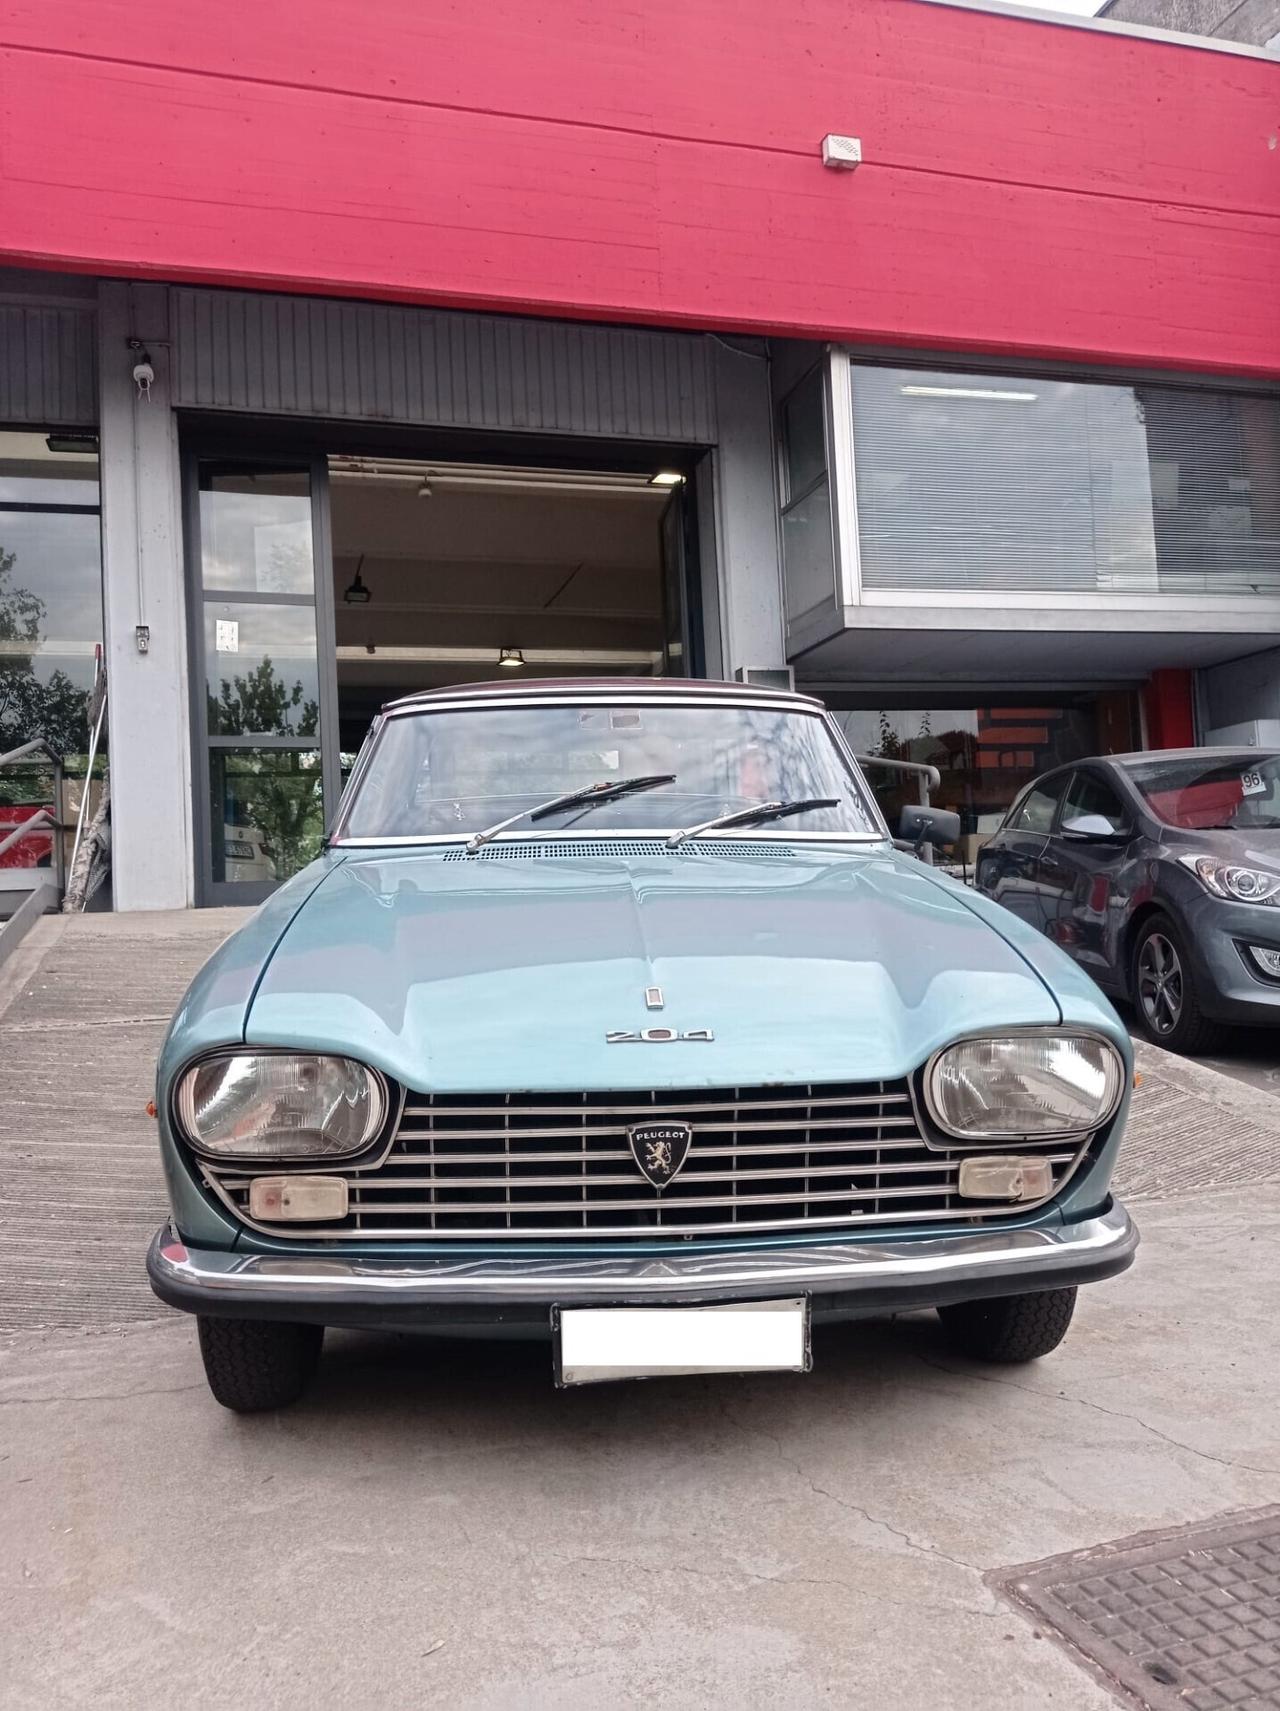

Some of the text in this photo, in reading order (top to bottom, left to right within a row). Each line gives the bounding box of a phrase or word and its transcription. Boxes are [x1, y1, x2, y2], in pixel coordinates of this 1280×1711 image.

[1243, 772, 1260, 787] 96
[606, 1027, 714, 1043] 204
[636, 1131, 685, 1140] PEUGEOT
